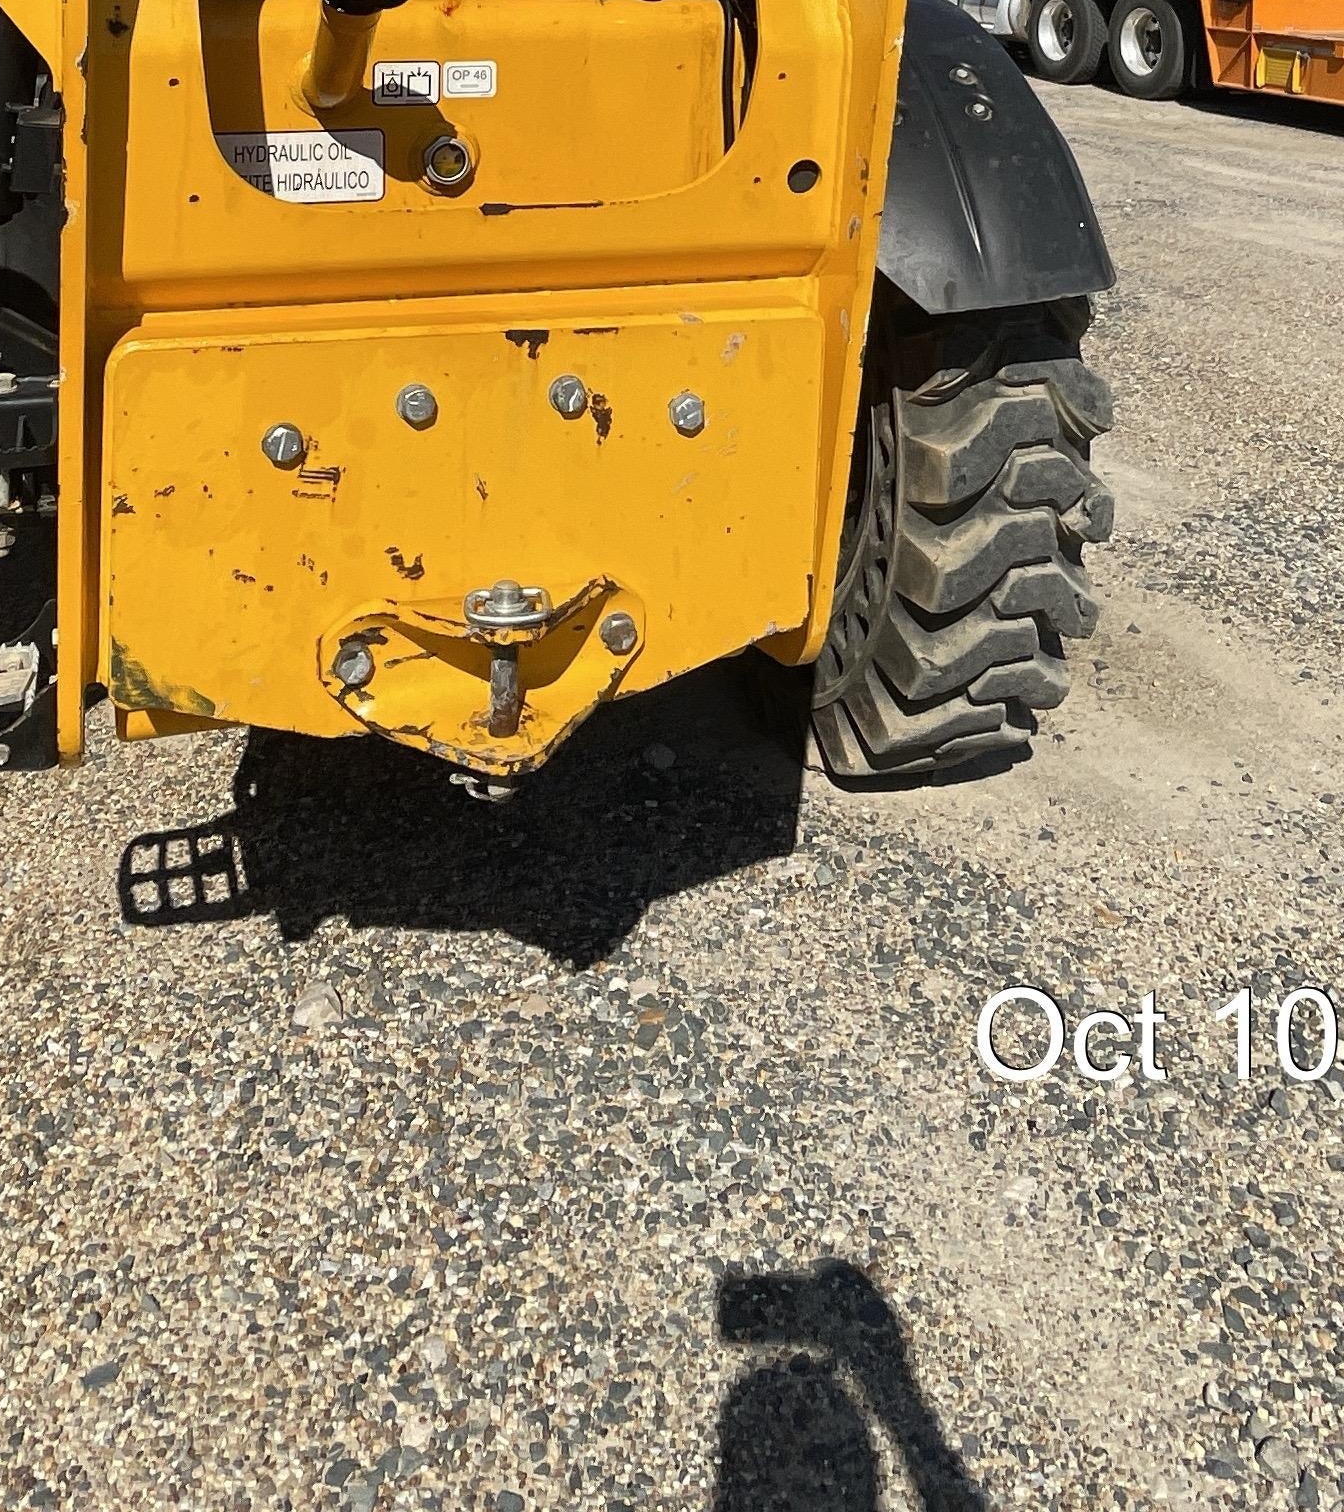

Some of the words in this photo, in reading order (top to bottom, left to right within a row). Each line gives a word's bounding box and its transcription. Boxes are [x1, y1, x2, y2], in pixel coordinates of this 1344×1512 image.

[451, 69, 470, 80] OP
[234, 143, 324, 164] HYDRAULIC
[328, 142, 353, 162] OIL
[277, 168, 370, 192] HIDRÁULICO
